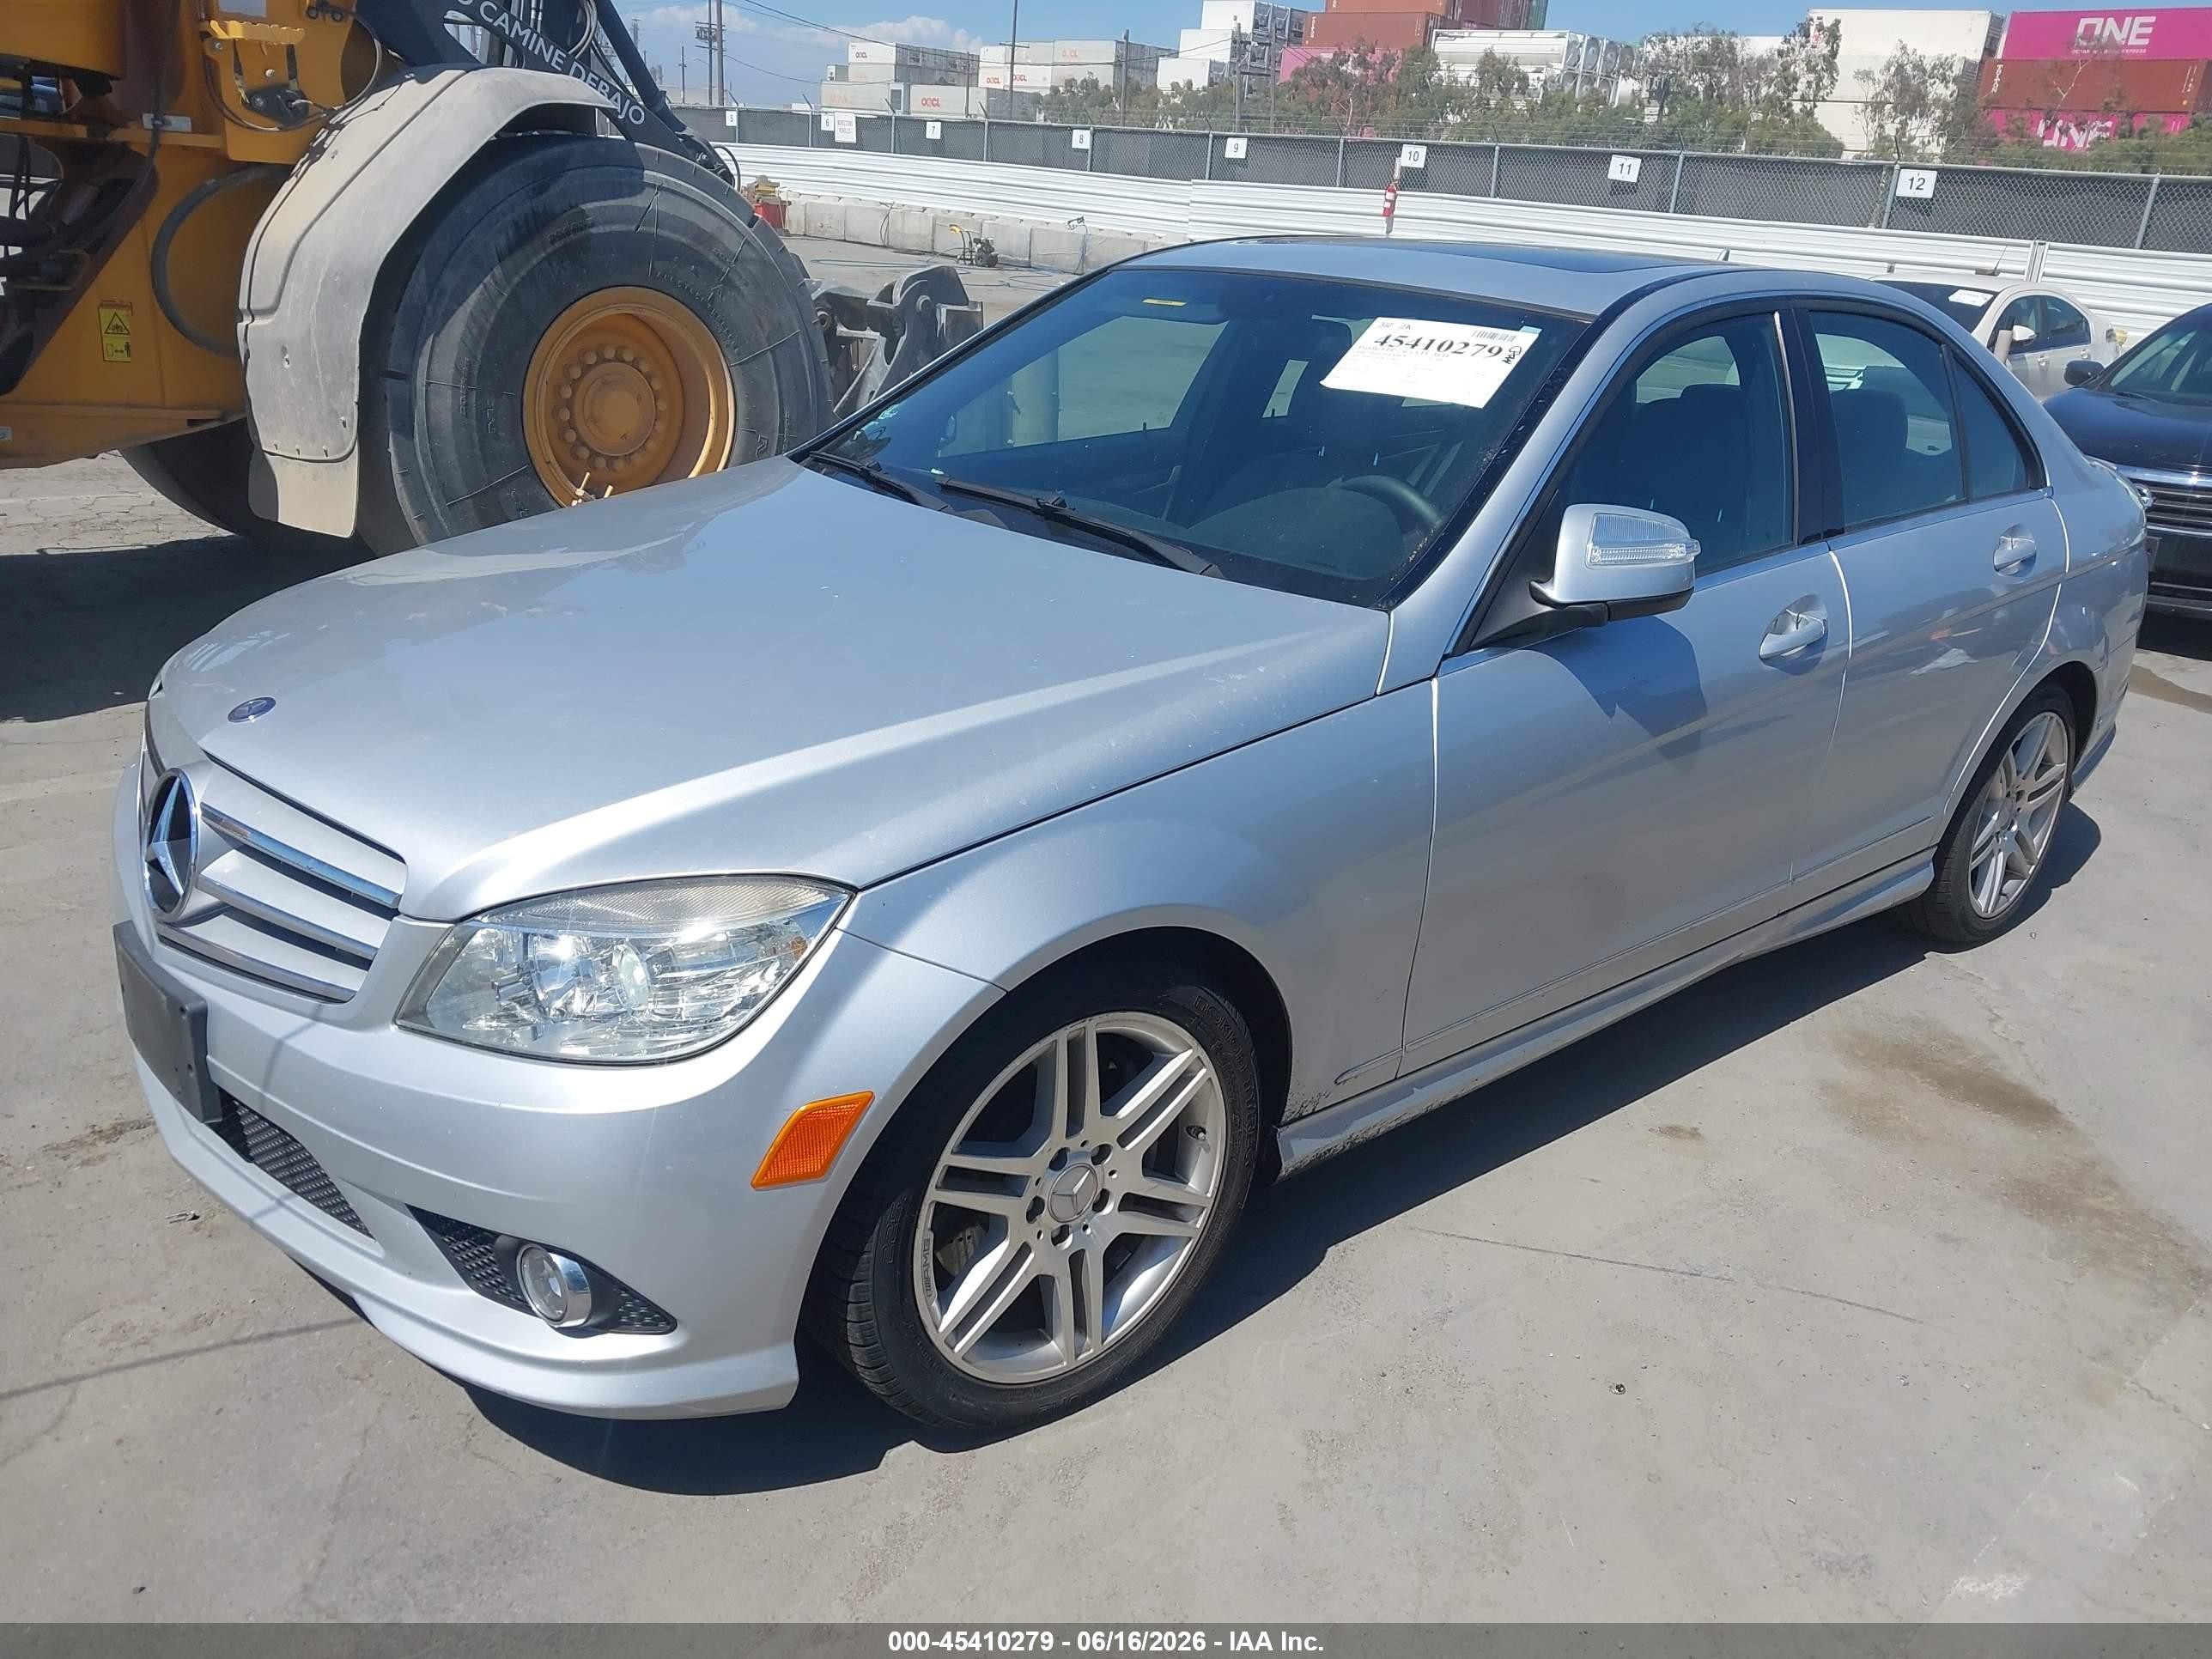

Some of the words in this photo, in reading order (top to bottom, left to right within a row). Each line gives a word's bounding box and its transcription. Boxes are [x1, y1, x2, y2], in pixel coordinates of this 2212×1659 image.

[2075, 15, 2157, 46] ONE
[479, 1, 567, 71] CAMINE
[568, 61, 645, 125] DEBAJO
[1079, 134, 1084, 144] 8
[1233, 143, 1239, 153] 9
[1408, 150, 1419, 162] 10
[1619, 162, 1632, 175] 11
[1908, 176, 1926, 191] 12
[1374, 333, 1503, 359] 45410279
